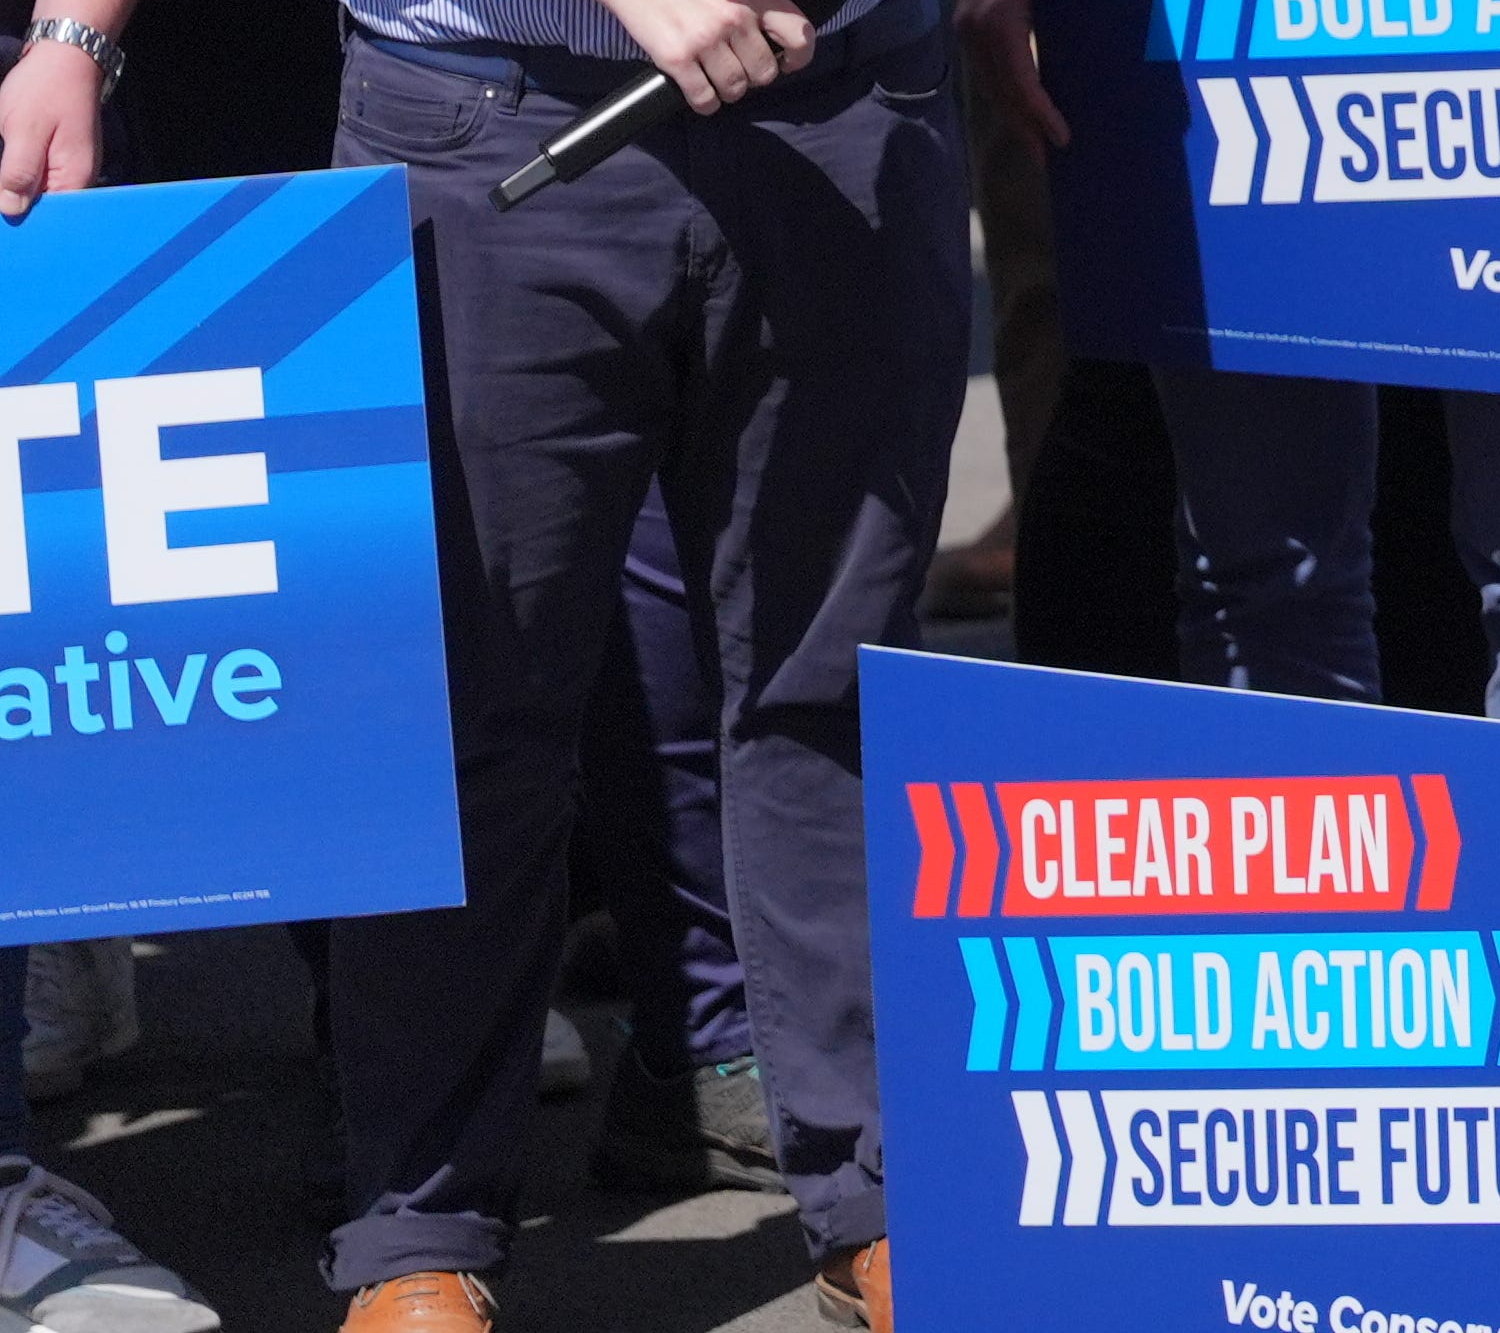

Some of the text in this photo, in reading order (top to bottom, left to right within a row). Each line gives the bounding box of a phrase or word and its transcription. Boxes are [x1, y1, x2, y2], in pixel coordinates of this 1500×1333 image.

[0, 366, 279, 615] TE
[1020, 792, 1390, 900] CLEAR PLAN
[1075, 948, 1471, 1053] BOLD ACTION
[1129, 1107, 1359, 1209] SECURE
[1221, 1279, 1318, 1333] Vote
